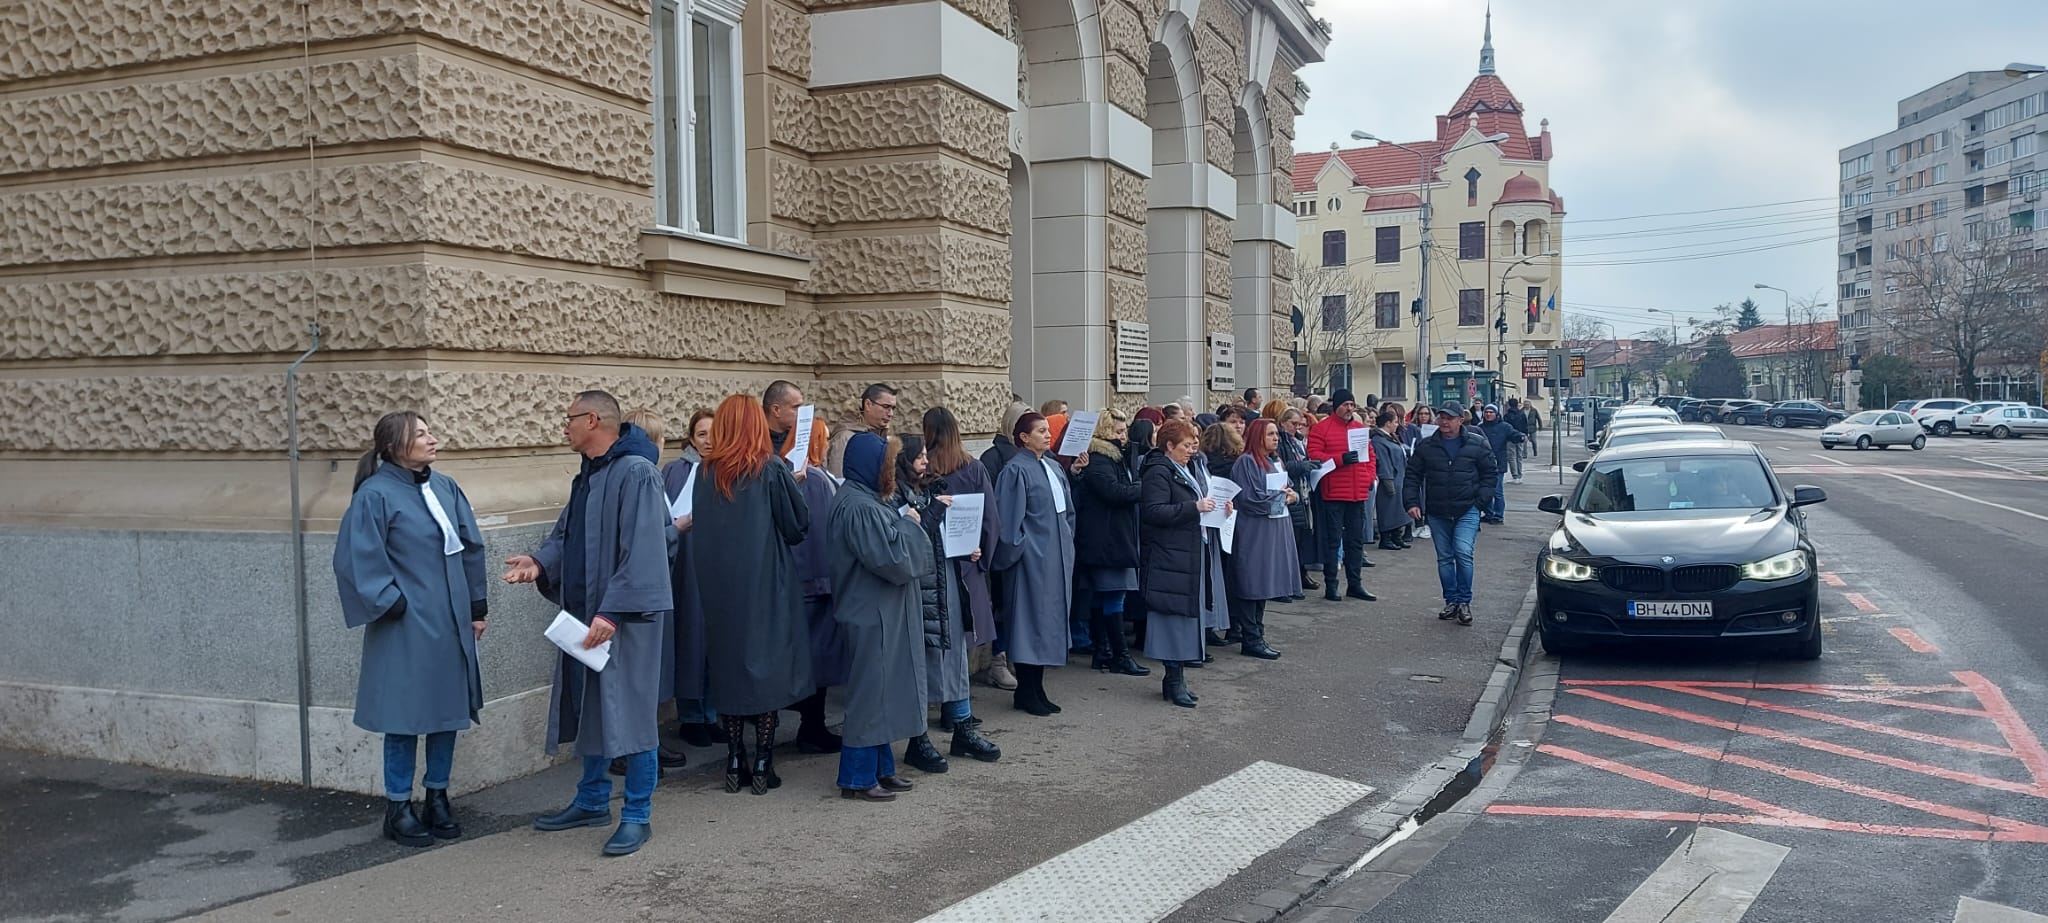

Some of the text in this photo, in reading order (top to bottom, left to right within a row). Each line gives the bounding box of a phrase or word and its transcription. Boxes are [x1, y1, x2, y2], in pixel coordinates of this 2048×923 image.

[1636, 603, 1657, 616] BH
[1662, 603, 1679, 616] 44
[1681, 603, 1711, 616] DNA
